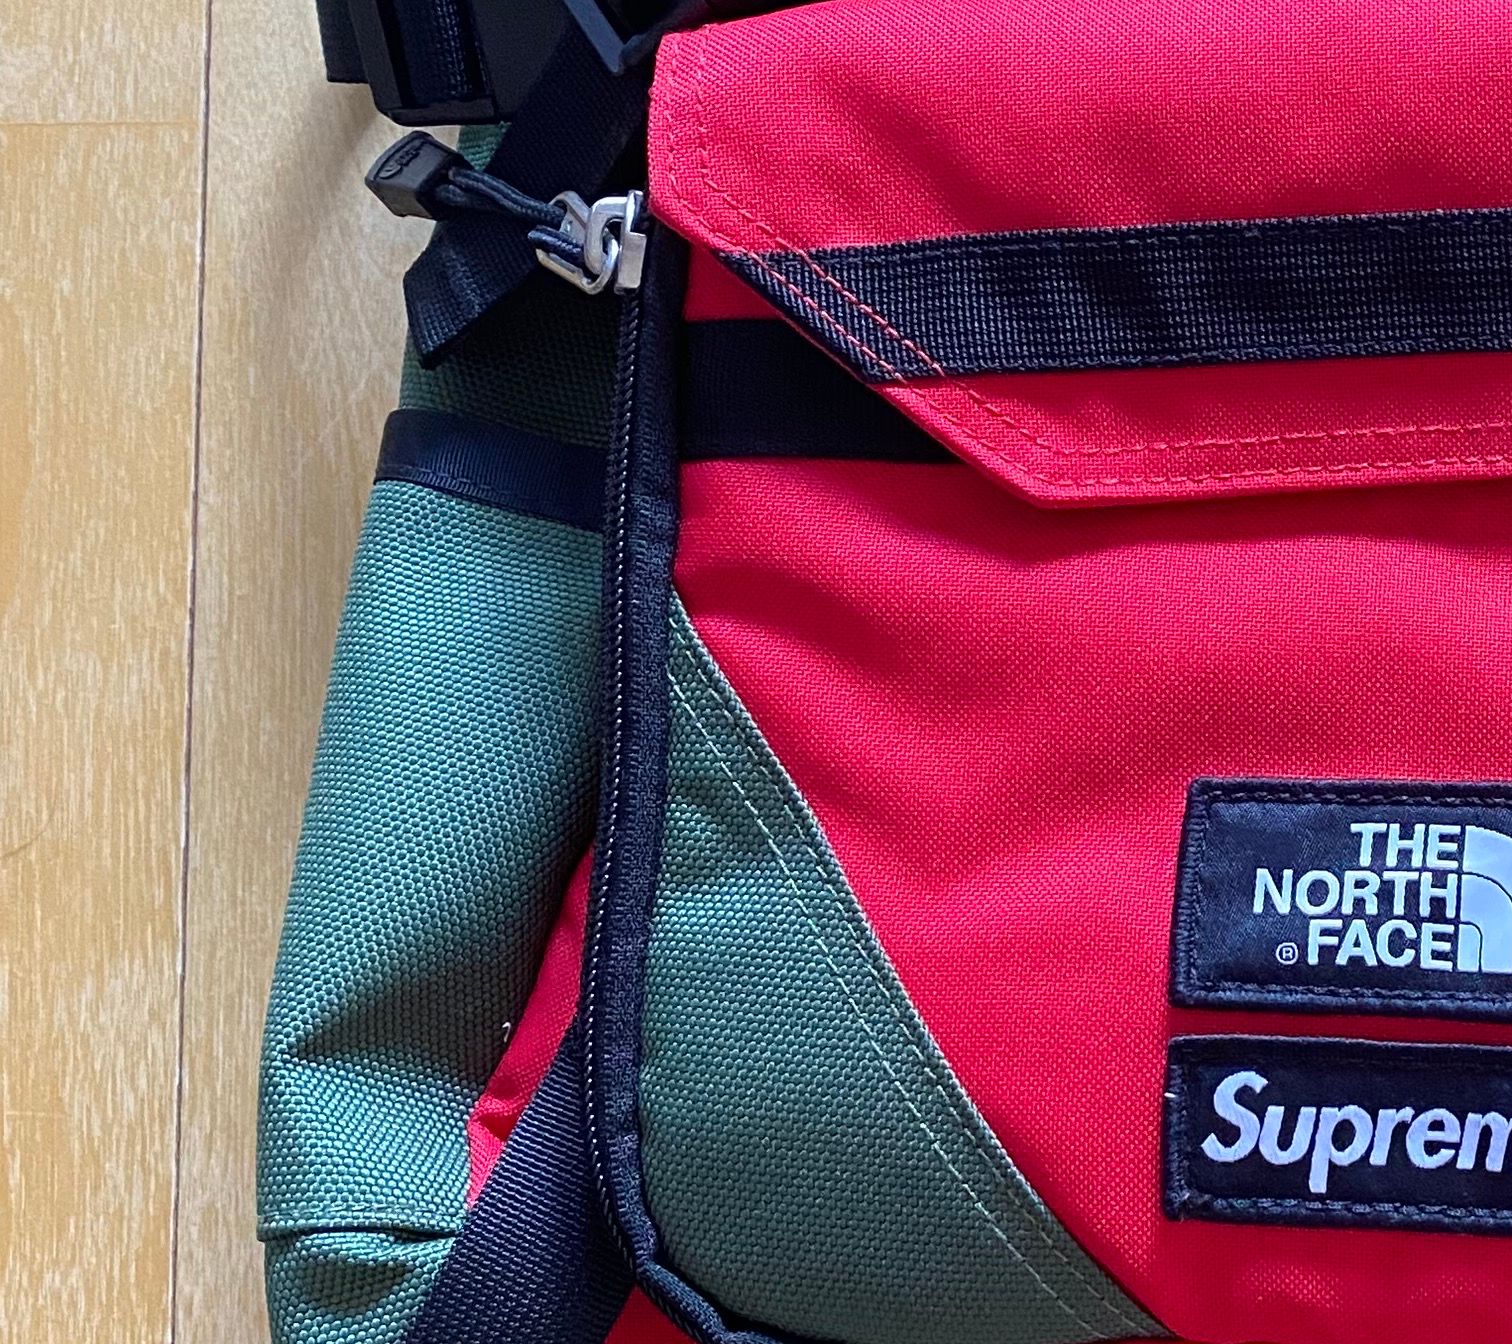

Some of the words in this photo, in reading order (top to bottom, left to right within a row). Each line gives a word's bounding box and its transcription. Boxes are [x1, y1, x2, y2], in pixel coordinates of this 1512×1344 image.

[1350, 822, 1459, 869] THE
[1253, 868, 1458, 919] NORTH
[1307, 920, 1453, 971] FACE
